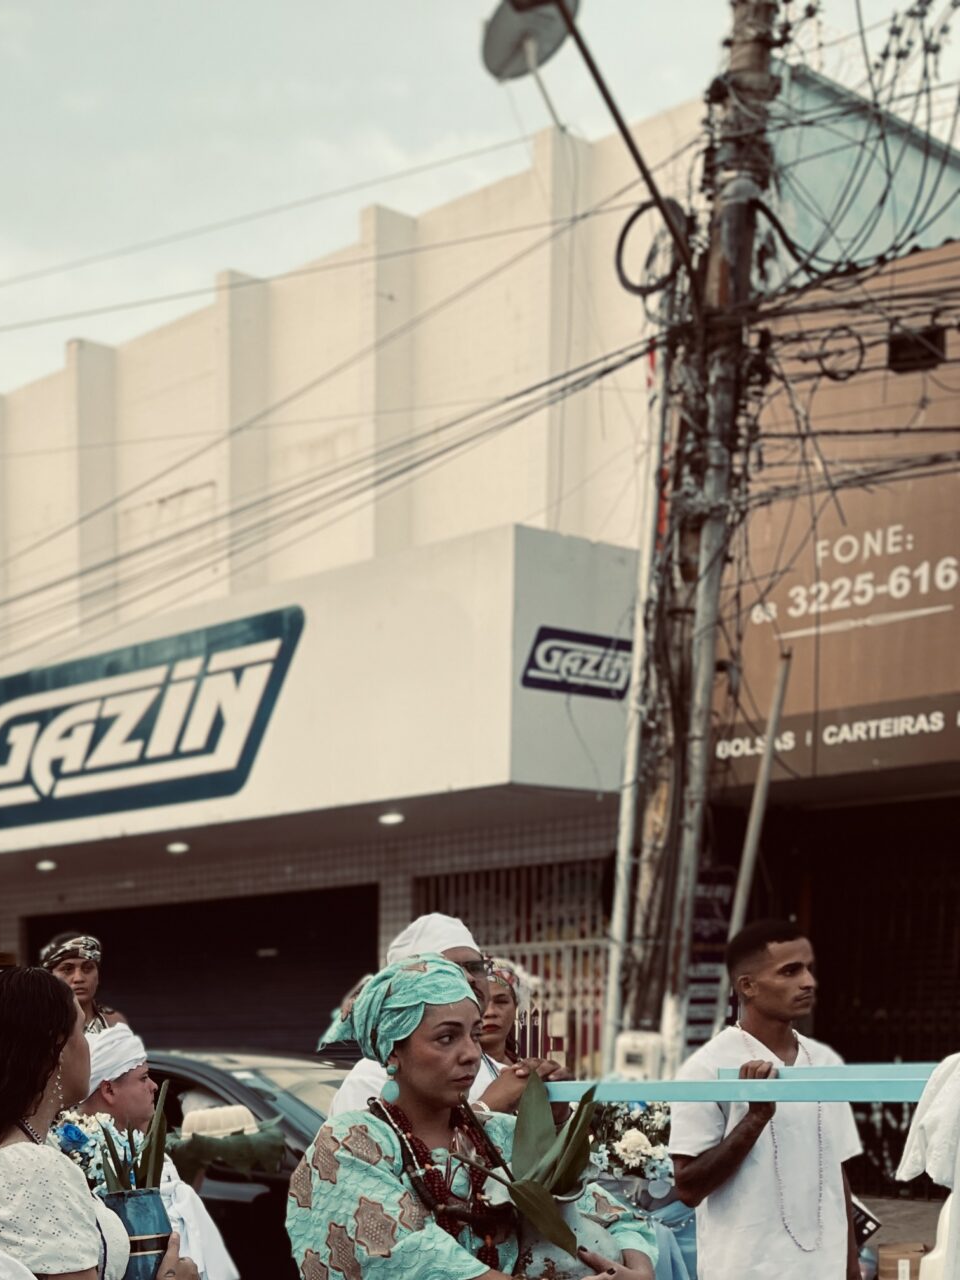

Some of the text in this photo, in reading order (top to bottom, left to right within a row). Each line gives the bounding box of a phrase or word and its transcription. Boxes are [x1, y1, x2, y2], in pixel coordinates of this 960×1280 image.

[816, 525, 914, 567] FONE:
[787, 556, 959, 618] 3225-616
[823, 712, 945, 745] CARTEIRAS
